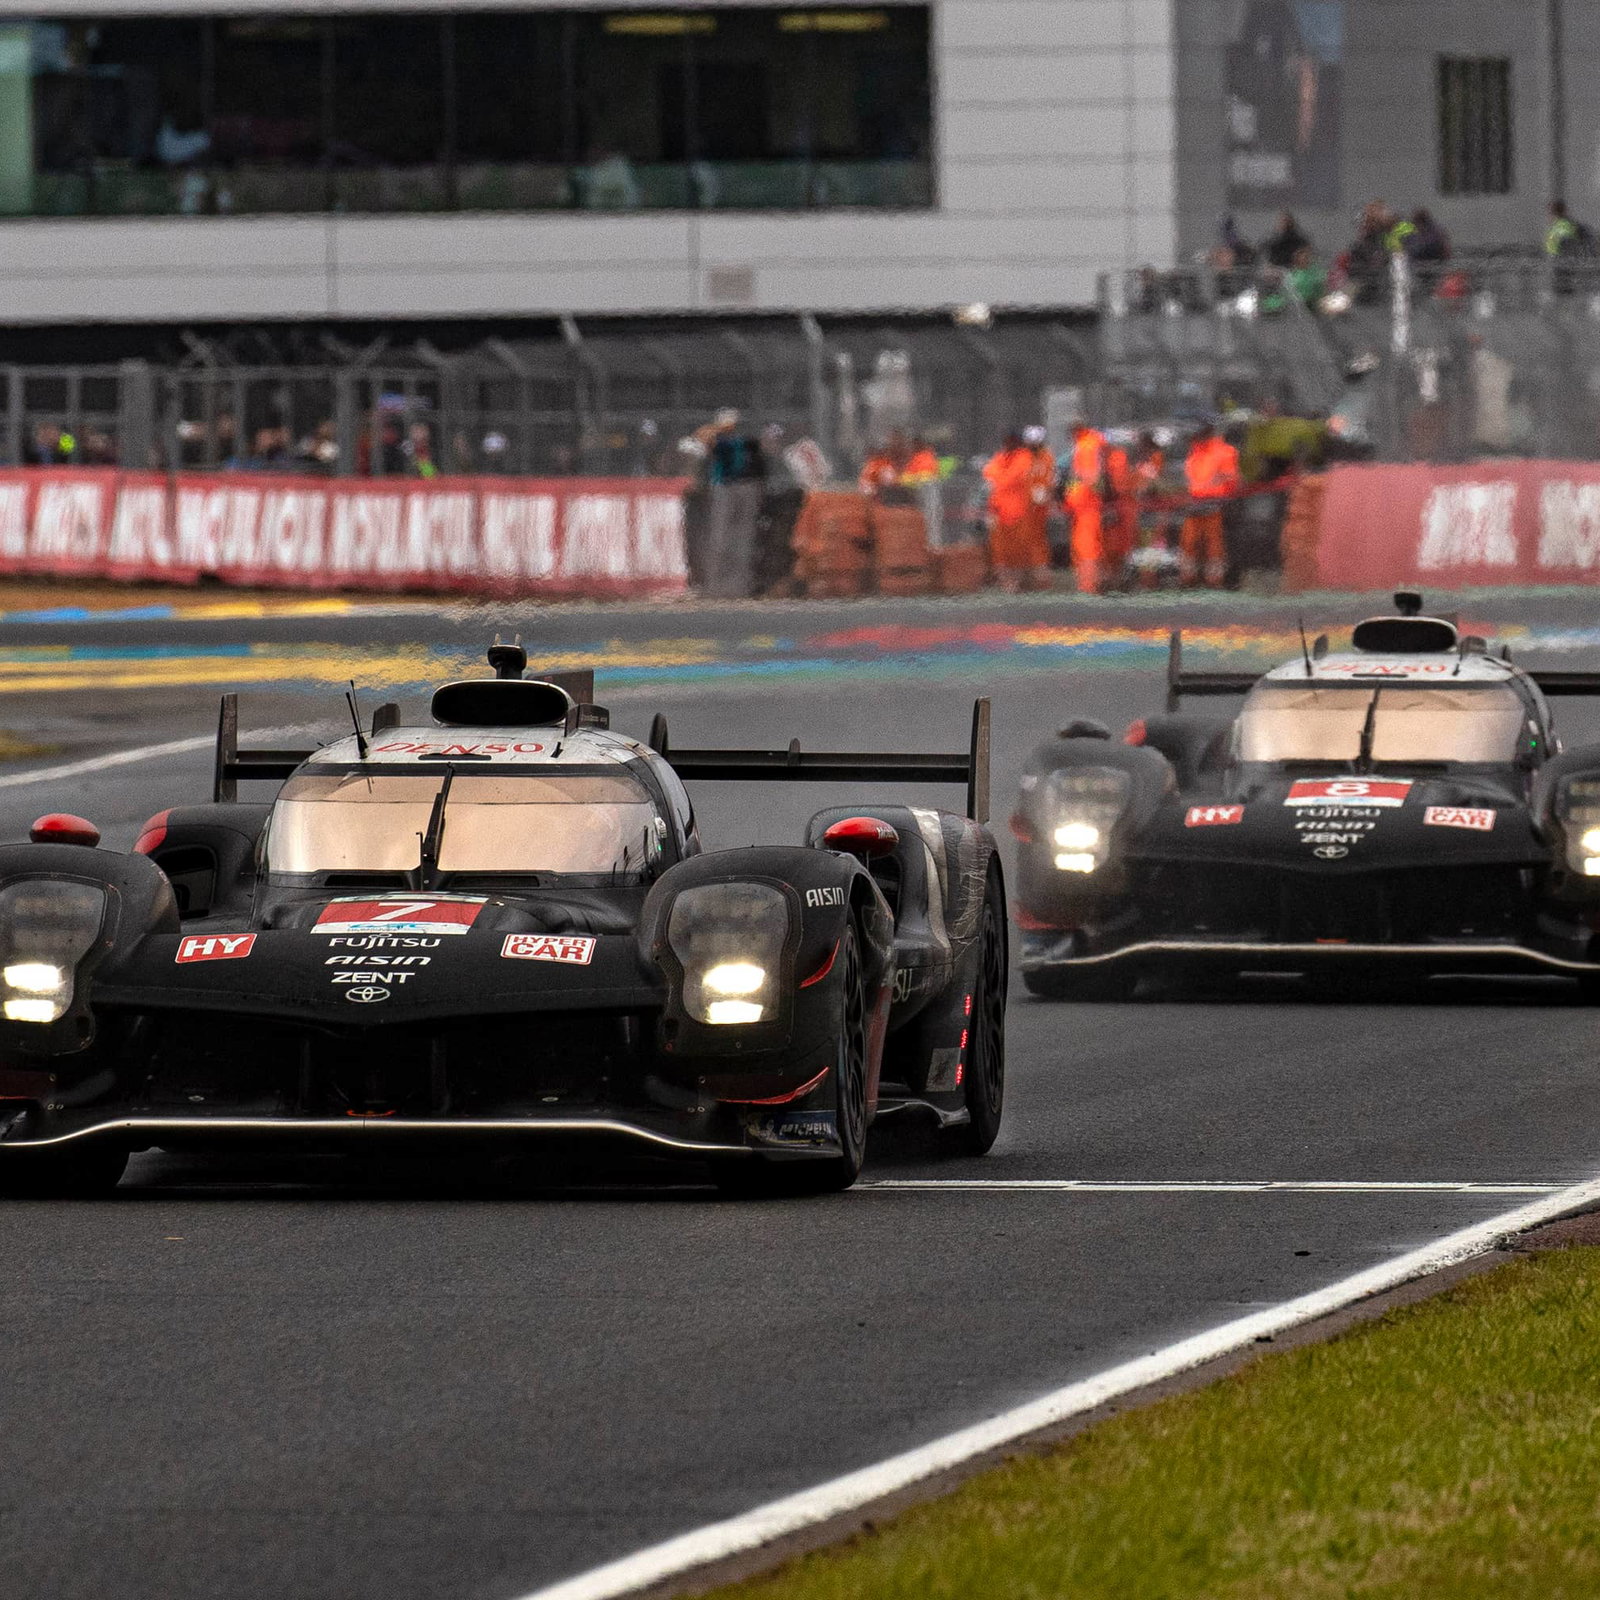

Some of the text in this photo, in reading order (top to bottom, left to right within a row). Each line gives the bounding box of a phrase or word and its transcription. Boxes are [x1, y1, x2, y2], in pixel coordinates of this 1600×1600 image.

[374, 742, 545, 755] DENSO
[1325, 782, 1371, 797] 8
[1191, 807, 1237, 823] HY
[1432, 813, 1487, 827] CAR
[1301, 832, 1366, 843] ZENT
[805, 886, 846, 908] AISIN
[370, 901, 437, 921] 7
[182, 936, 250, 957] HY
[328, 934, 442, 950] FUJITSU
[513, 936, 588, 948] HYPER
[510, 942, 585, 961] CAR
[324, 955, 432, 966] AISIN
[331, 971, 416, 984] ZENT
